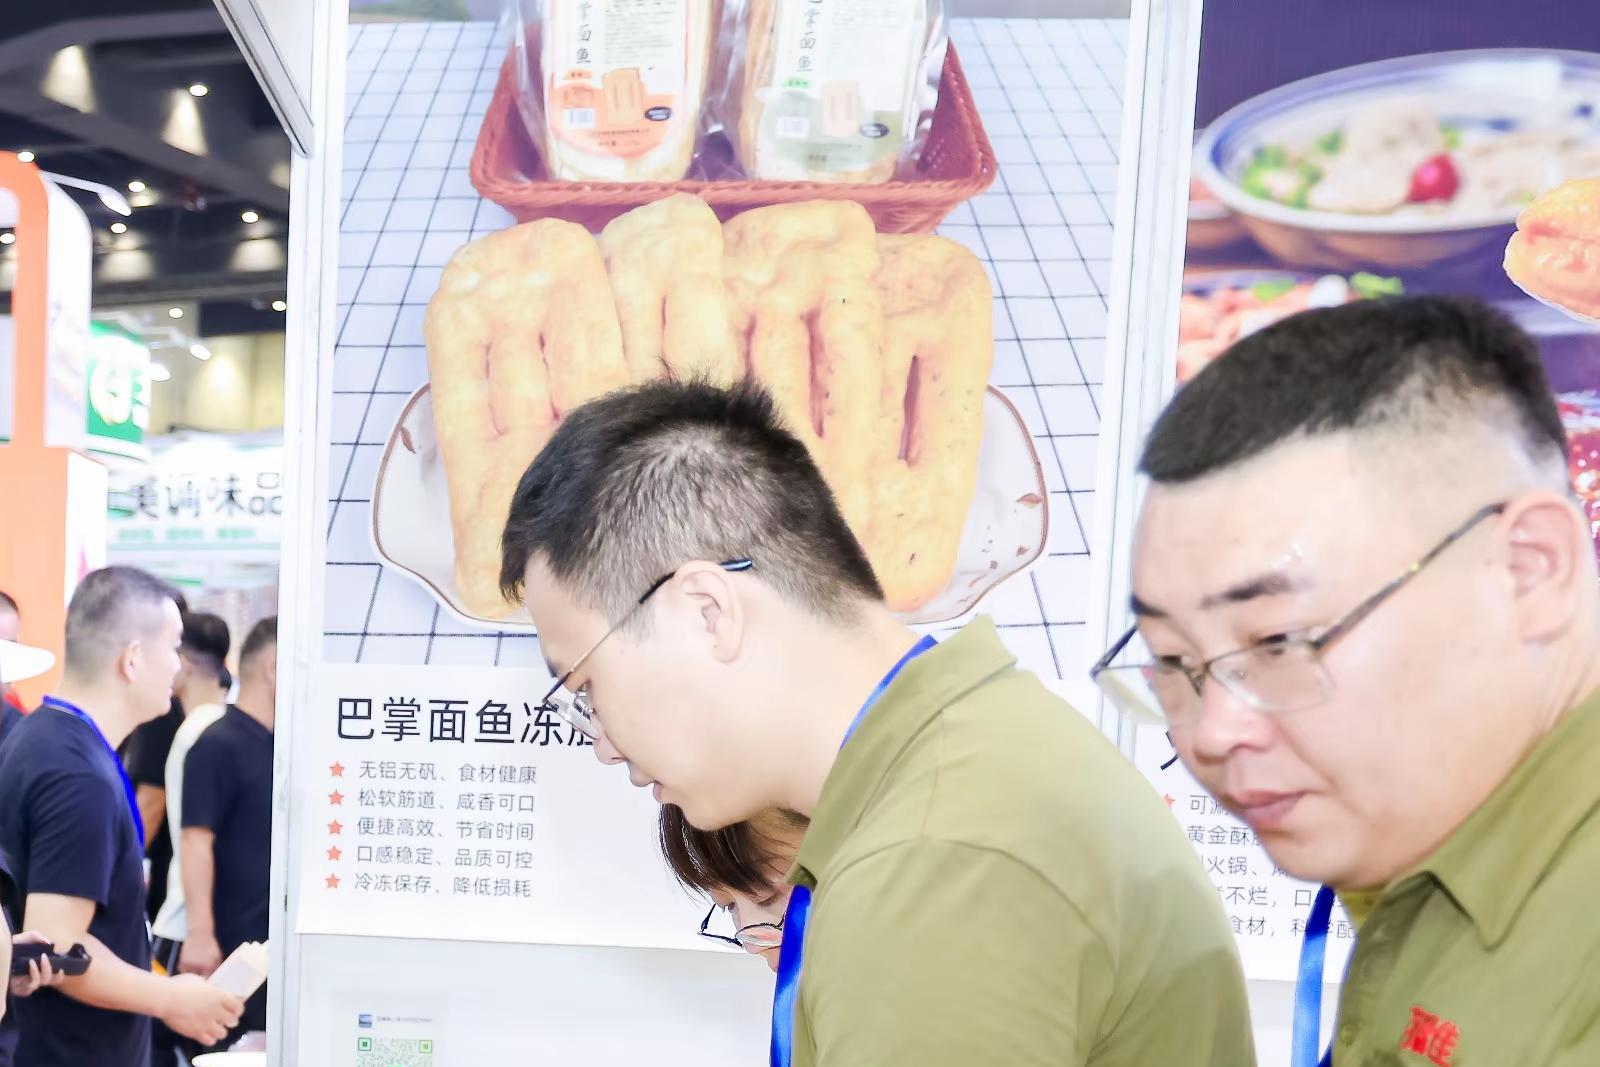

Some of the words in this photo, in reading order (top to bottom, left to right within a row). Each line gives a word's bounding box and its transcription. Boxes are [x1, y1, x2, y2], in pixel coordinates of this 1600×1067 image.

[359, 761, 538, 785] 无铝无矾、食材健康
[357, 789, 536, 813] 松软筋道、咸香可口
[356, 817, 535, 841] 便捷高效、节省时间
[356, 845, 534, 870] 口感稳定、品质可控
[353, 873, 532, 898] 冷冻保存、降低损耗
